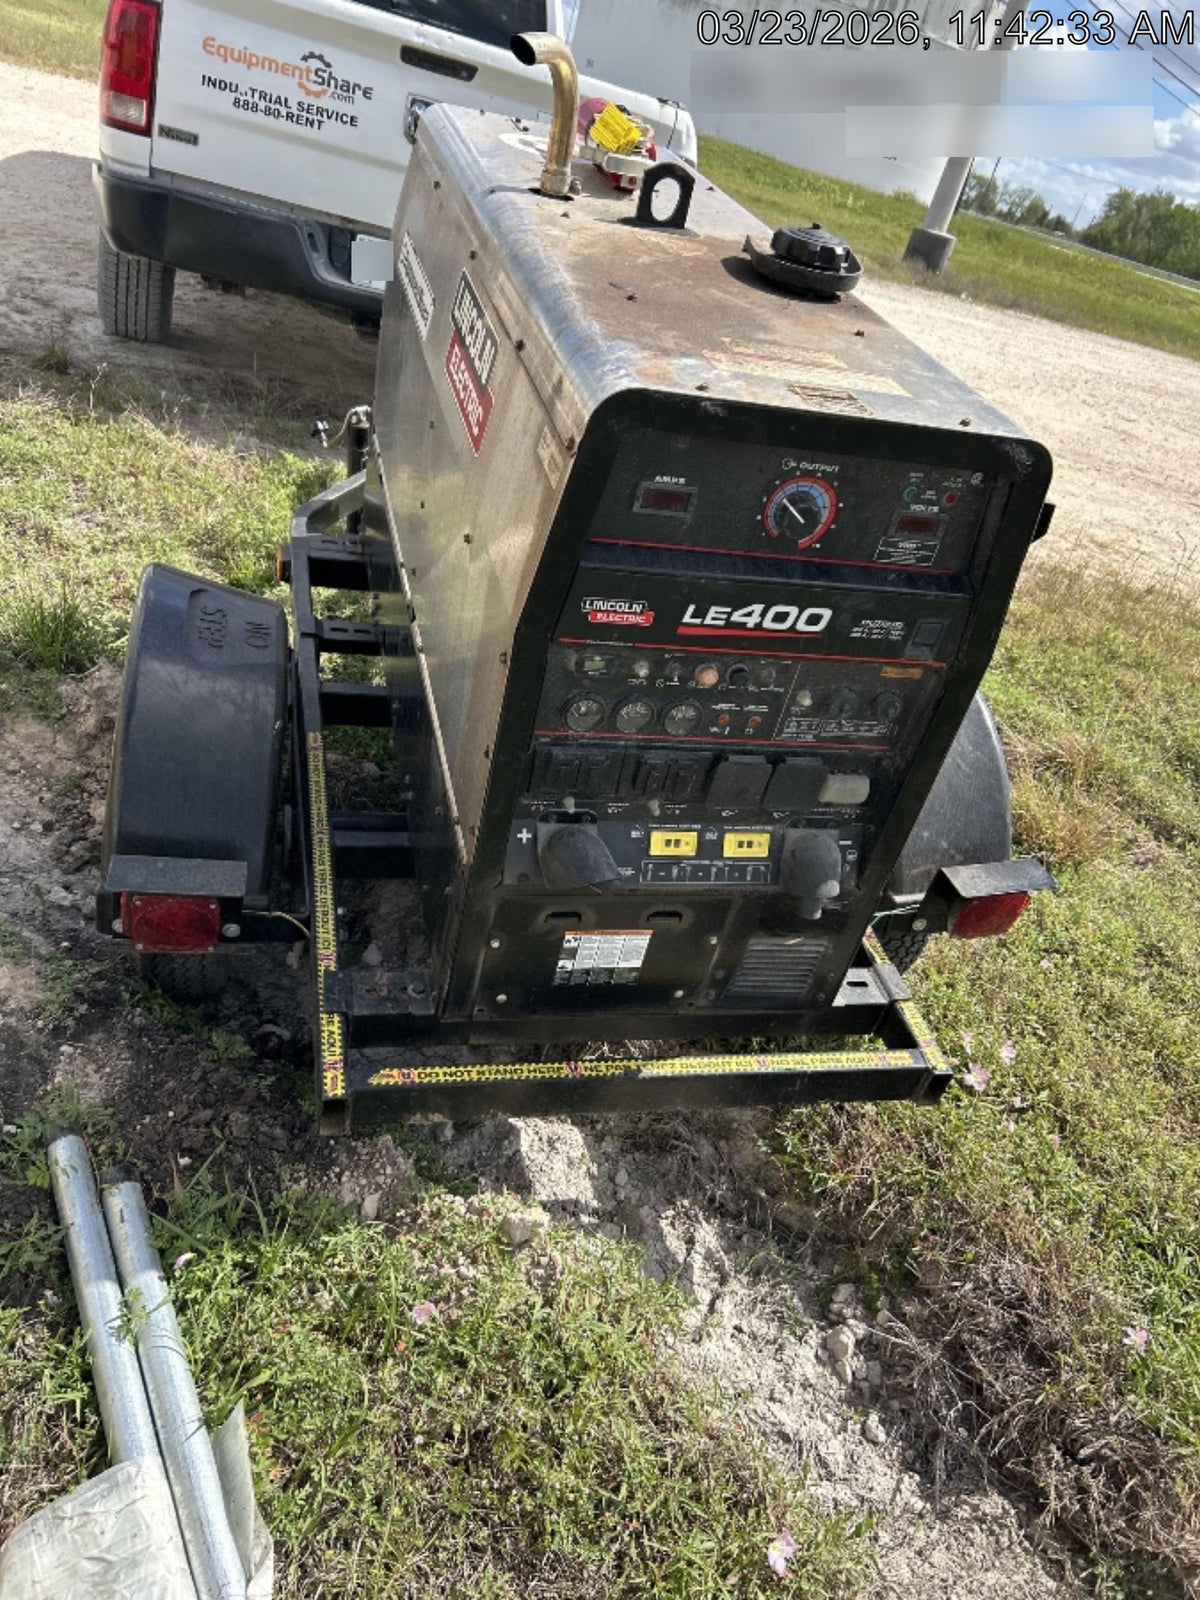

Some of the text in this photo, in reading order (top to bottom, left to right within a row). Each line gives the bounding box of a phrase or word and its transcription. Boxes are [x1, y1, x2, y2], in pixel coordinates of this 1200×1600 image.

[201, 74, 359, 128] INDUTRIAL SERVICE
[232, 97, 325, 132] 888-80-RENT
[454, 281, 496, 384] LINCOLN
[449, 344, 484, 437] ELECTRIC
[799, 461, 840, 473] OUTPUT
[584, 598, 644, 614] LINCOLN
[595, 612, 648, 625] ELECTRIC
[681, 602, 833, 634] LE400
[417, 1071, 439, 1081] DO
[442, 1069, 474, 1080] NOT
